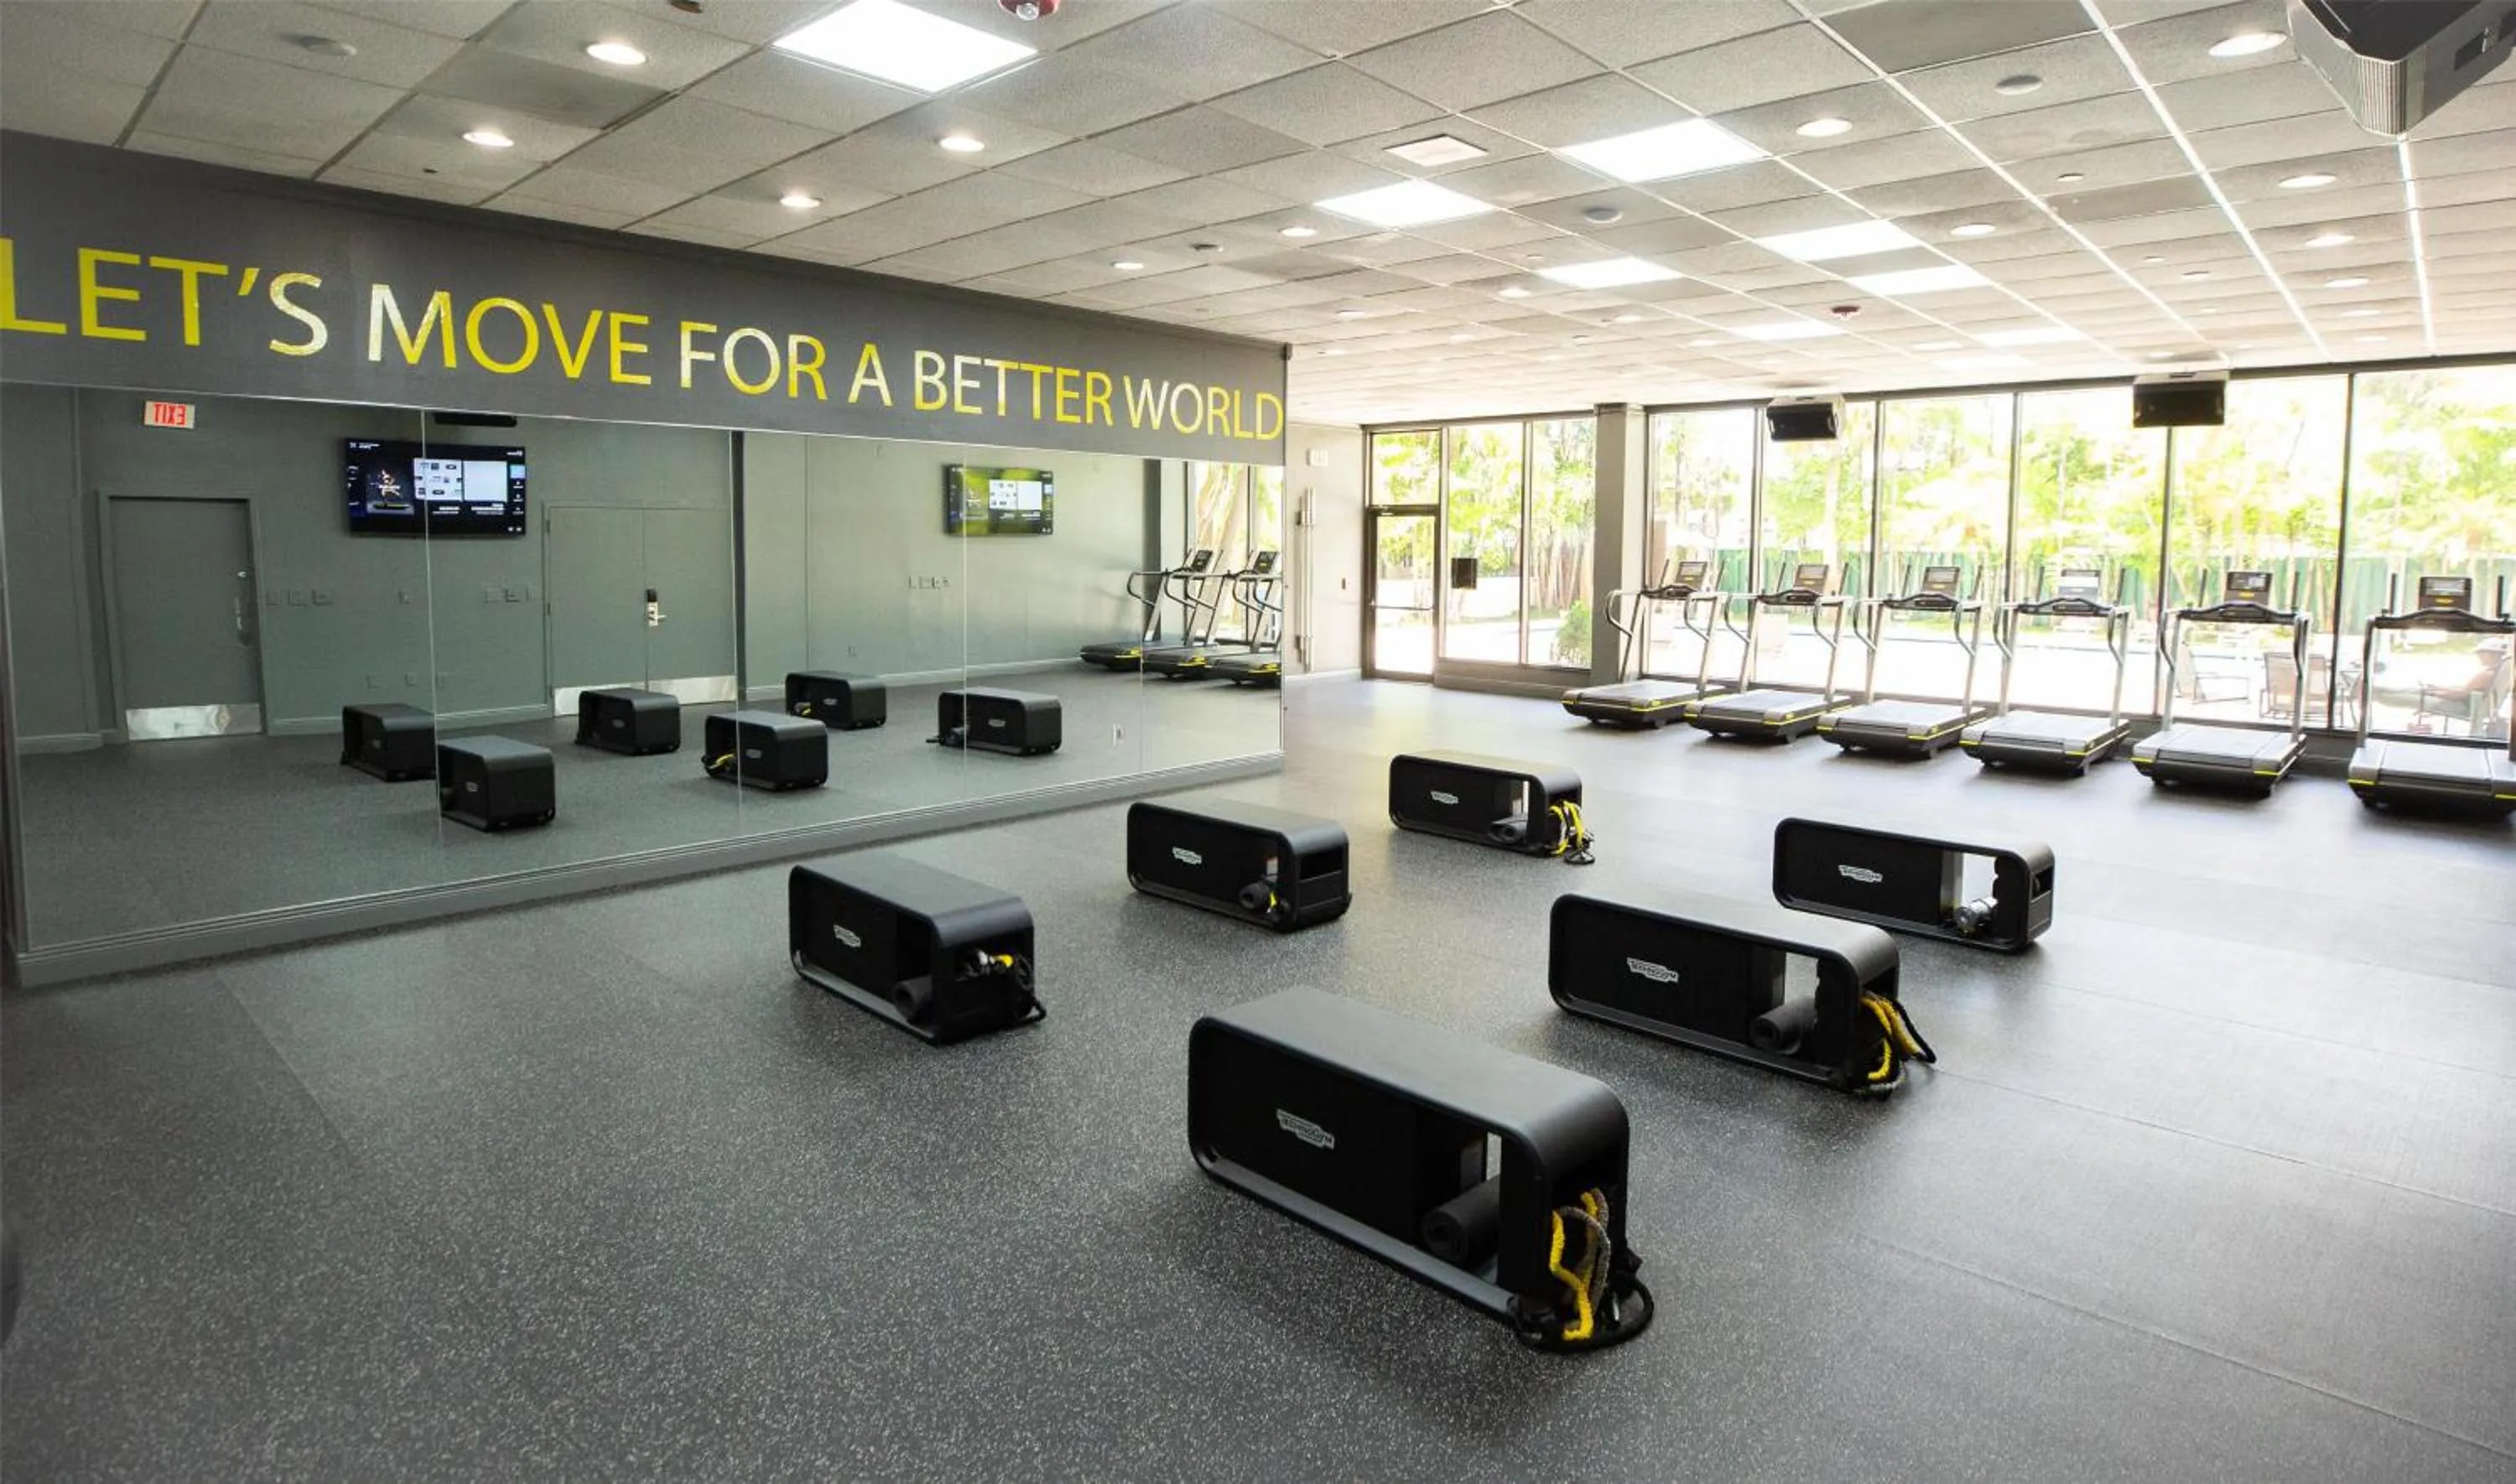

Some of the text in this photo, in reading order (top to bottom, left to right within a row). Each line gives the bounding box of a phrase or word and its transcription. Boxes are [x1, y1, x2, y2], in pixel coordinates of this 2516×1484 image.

[0, 238, 1284, 441] LET'S MOVE FOR A BETTER WORLD
